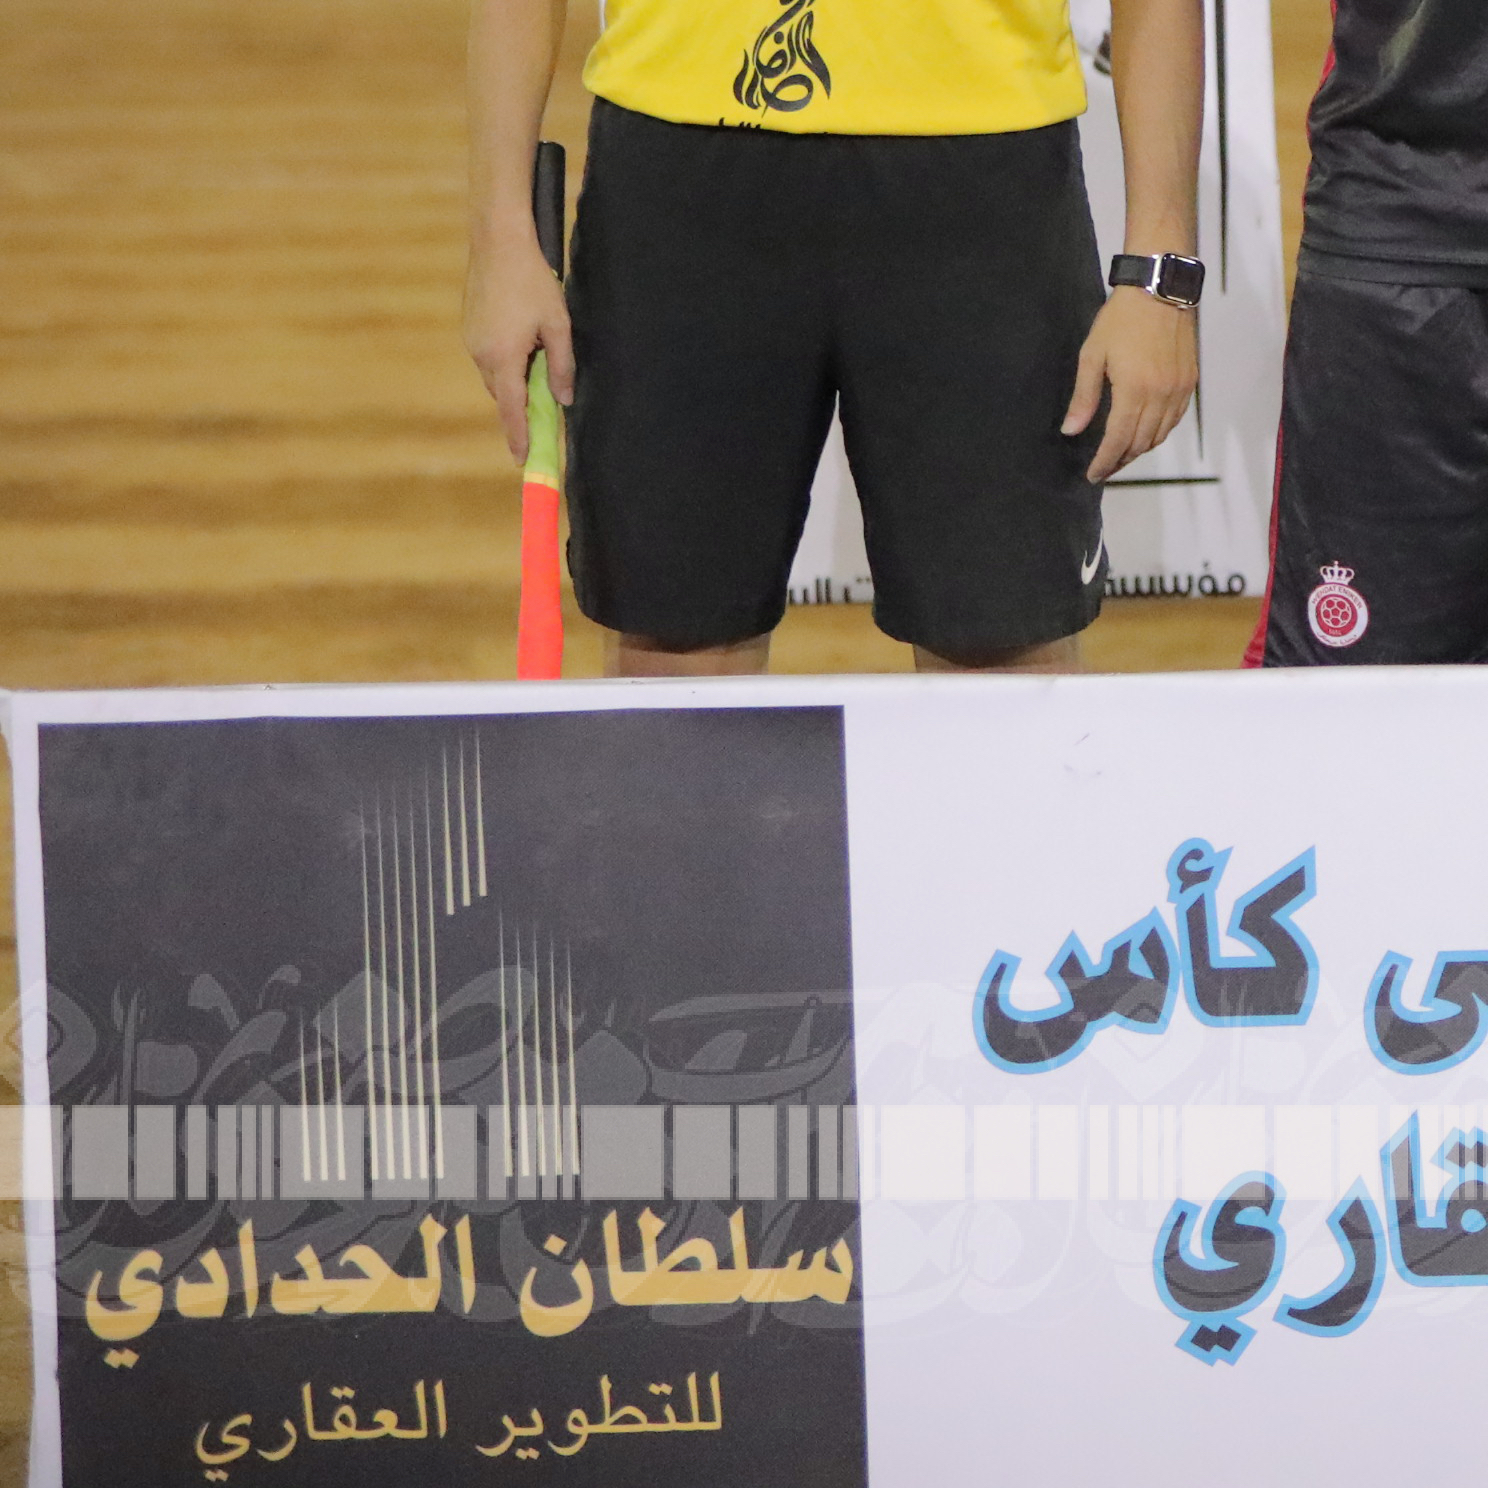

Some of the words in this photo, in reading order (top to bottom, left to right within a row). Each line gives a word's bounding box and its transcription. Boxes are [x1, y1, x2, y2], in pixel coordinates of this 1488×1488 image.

[972, 837, 1320, 1075] كأس
[84, 1212, 476, 1370] الحدادي
[519, 1206, 855, 1338] سلطان
[194, 1380, 448, 1483] العقاري
[475, 1372, 725, 1461] للتطوير
